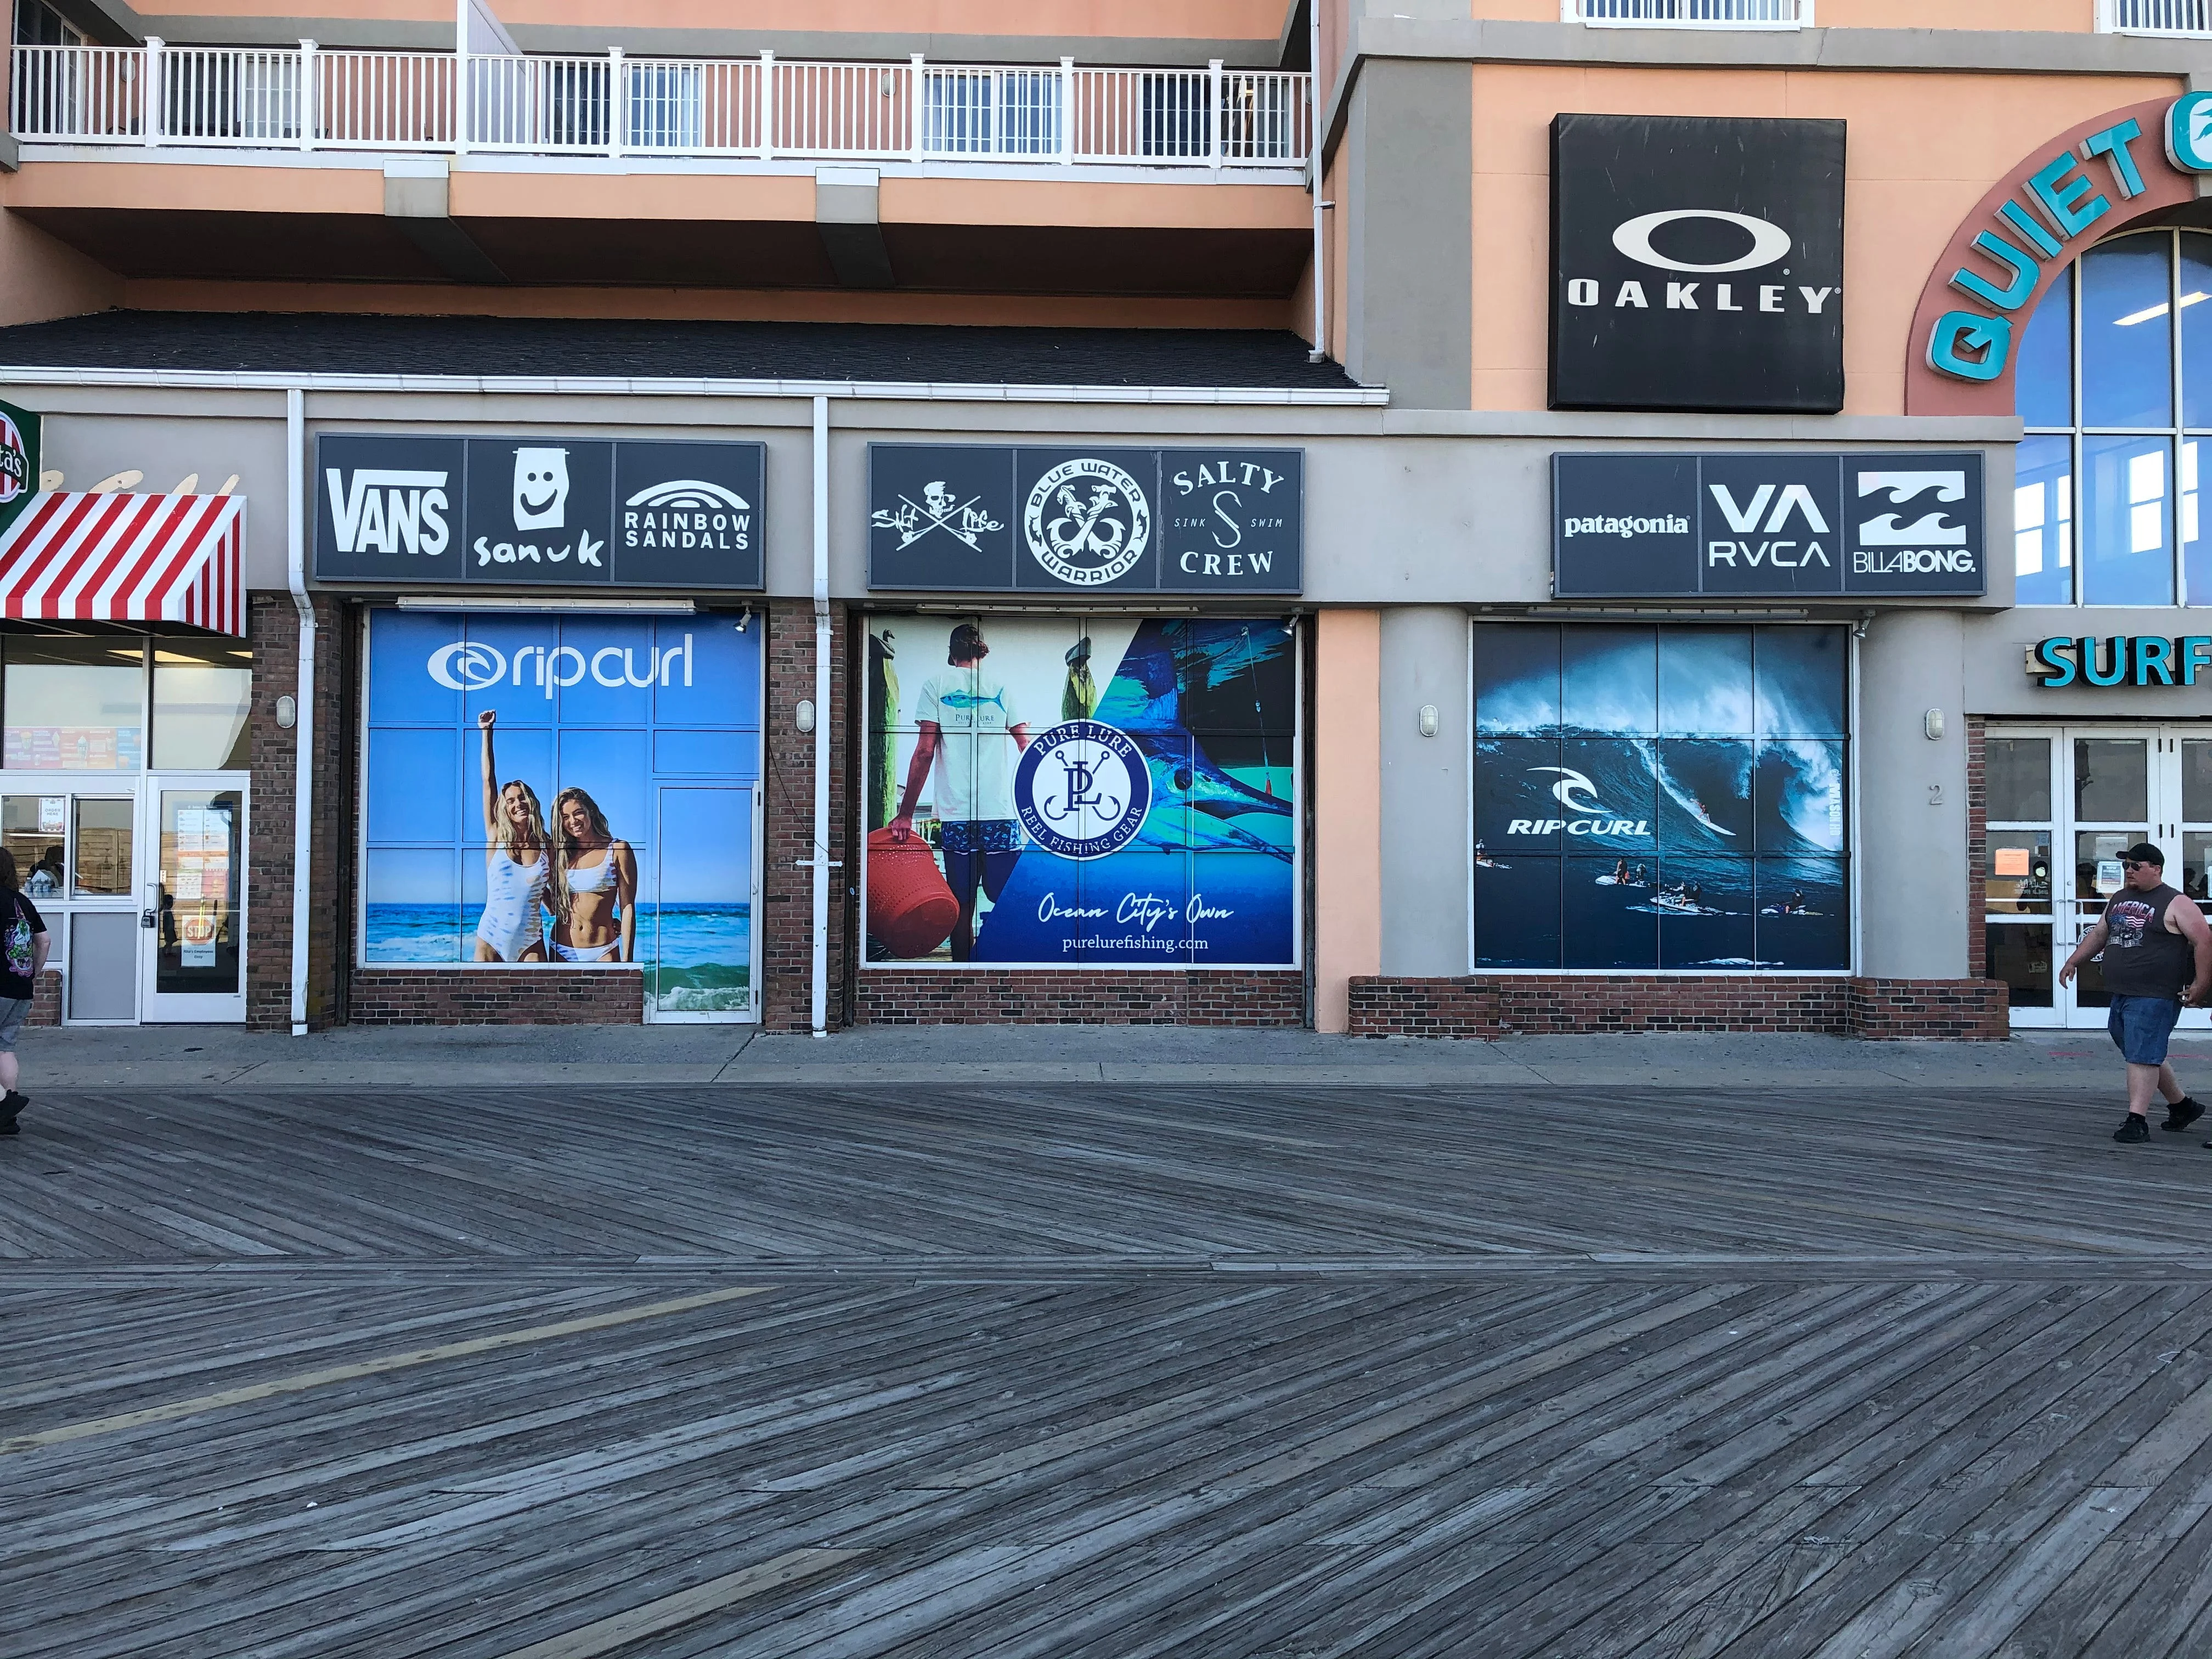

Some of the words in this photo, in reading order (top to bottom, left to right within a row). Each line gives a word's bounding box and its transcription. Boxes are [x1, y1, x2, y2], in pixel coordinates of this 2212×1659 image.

[1926, 117, 2147, 383] QUIET
[1567, 278, 1833, 314] OAKLEY
[1030, 464, 1074, 508] BLUE
[1081, 462, 1141, 503] WATER
[1173, 461, 1285, 496] SALTY
[326, 467, 450, 556] VANS
[624, 511, 751, 532] RAINBOW
[1174, 518, 1206, 528] SINK
[1250, 518, 1283, 528] SWIM
[473, 529, 605, 568] sanuk
[625, 529, 748, 550] SANDALS
[1708, 540, 1831, 568] RVCA
[1041, 549, 1138, 582] WARRIOR
[1180, 550, 1274, 575] CREW
[2034, 636, 2212, 687] SURF
[1033, 724, 1080, 756] PURE
[1086, 725, 1132, 758] LURE
[1928, 785, 1943, 805] 2
[1021, 805, 1048, 840] REEL
[1050, 836, 1111, 855] FISHING
[1113, 806, 1142, 842] GEAR
[1038, 892, 1109, 923] Ocean
[1116, 892, 1178, 933] City's
[1186, 893, 1234, 924] Own
[1062, 934, 1209, 953] purelurefishing.com
